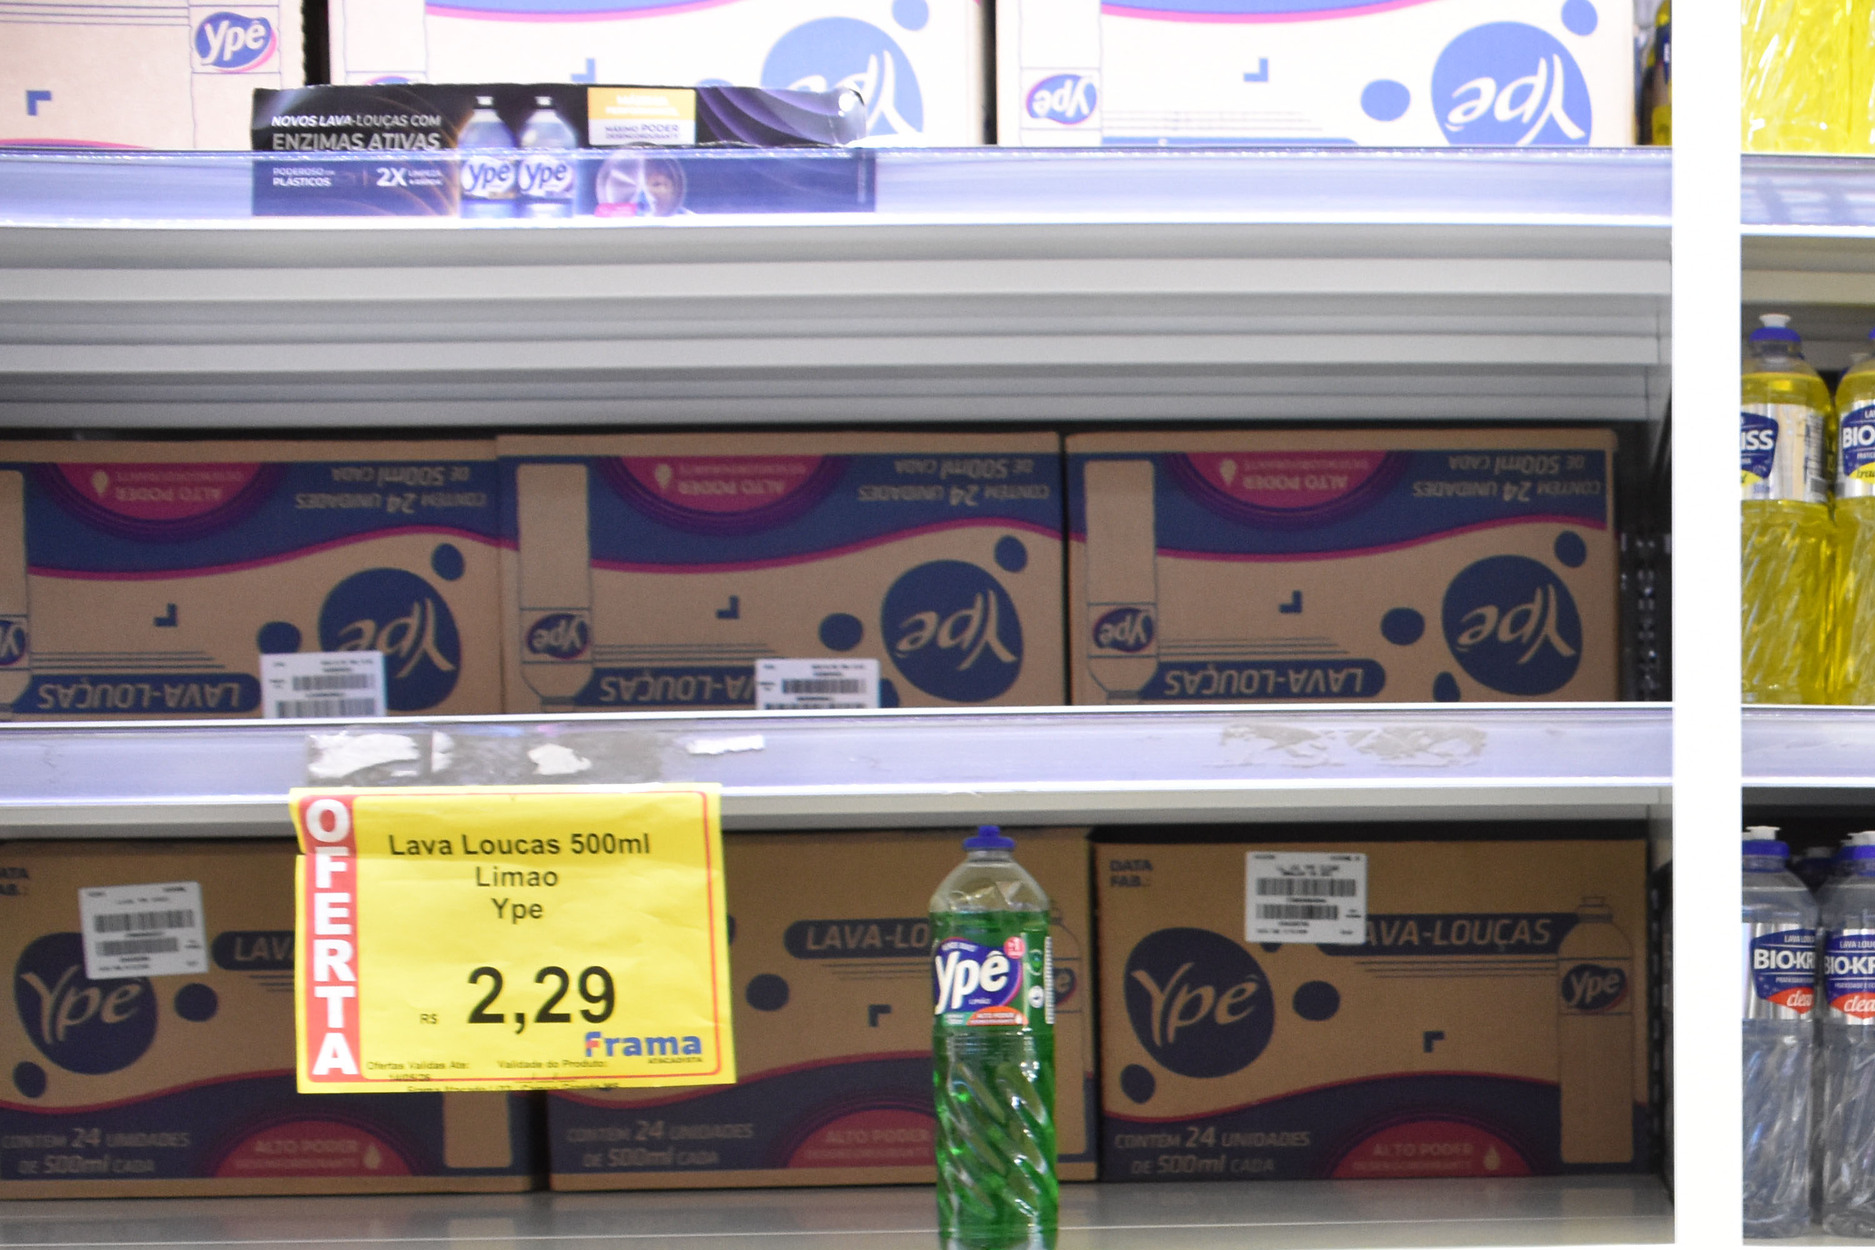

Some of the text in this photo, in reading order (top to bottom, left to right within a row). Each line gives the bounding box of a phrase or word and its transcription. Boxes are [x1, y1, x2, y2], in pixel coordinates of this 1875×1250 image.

[196, 14, 274, 69] Ypê
[271, 114, 441, 131] NOVOS LAVA-LOUÇAS COM
[641, 123, 679, 132] PODER
[273, 133, 441, 150] ENZIMAS ATIVAS
[376, 168, 408, 187] 2X
[1243, 474, 1349, 490] ALTO PODER
[1413, 481, 1531, 501] 24 UNIDADES
[1164, 667, 1363, 695] LAVA-LOUÇAS
[37, 674, 241, 710] LAVA-LOUÇAS
[388, 832, 650, 856] Lava Loucas 500ml
[1110, 858, 1153, 873] DATA
[476, 866, 558, 888] Limao
[491, 897, 543, 924] Ype
[305, 799, 358, 1076] OFERTA
[1366, 917, 1552, 951] AVA-LOUÇAS
[1840, 941, 1859, 949] LAVA
[934, 950, 1010, 1015] Ypê
[420, 965, 615, 1034] R$ 2,29
[1131, 962, 1261, 1049] Ypê
[367, 1061, 406, 1070] Ofertas
[497, 1059, 543, 1069] Validade
[546, 1059, 559, 1069] do
[1185, 1127, 1216, 1149] 24
[1221, 1130, 1310, 1148] UNIDADES
[1373, 1142, 1473, 1157] ALTO PODER
[1156, 1153, 1225, 1174] 500ml
